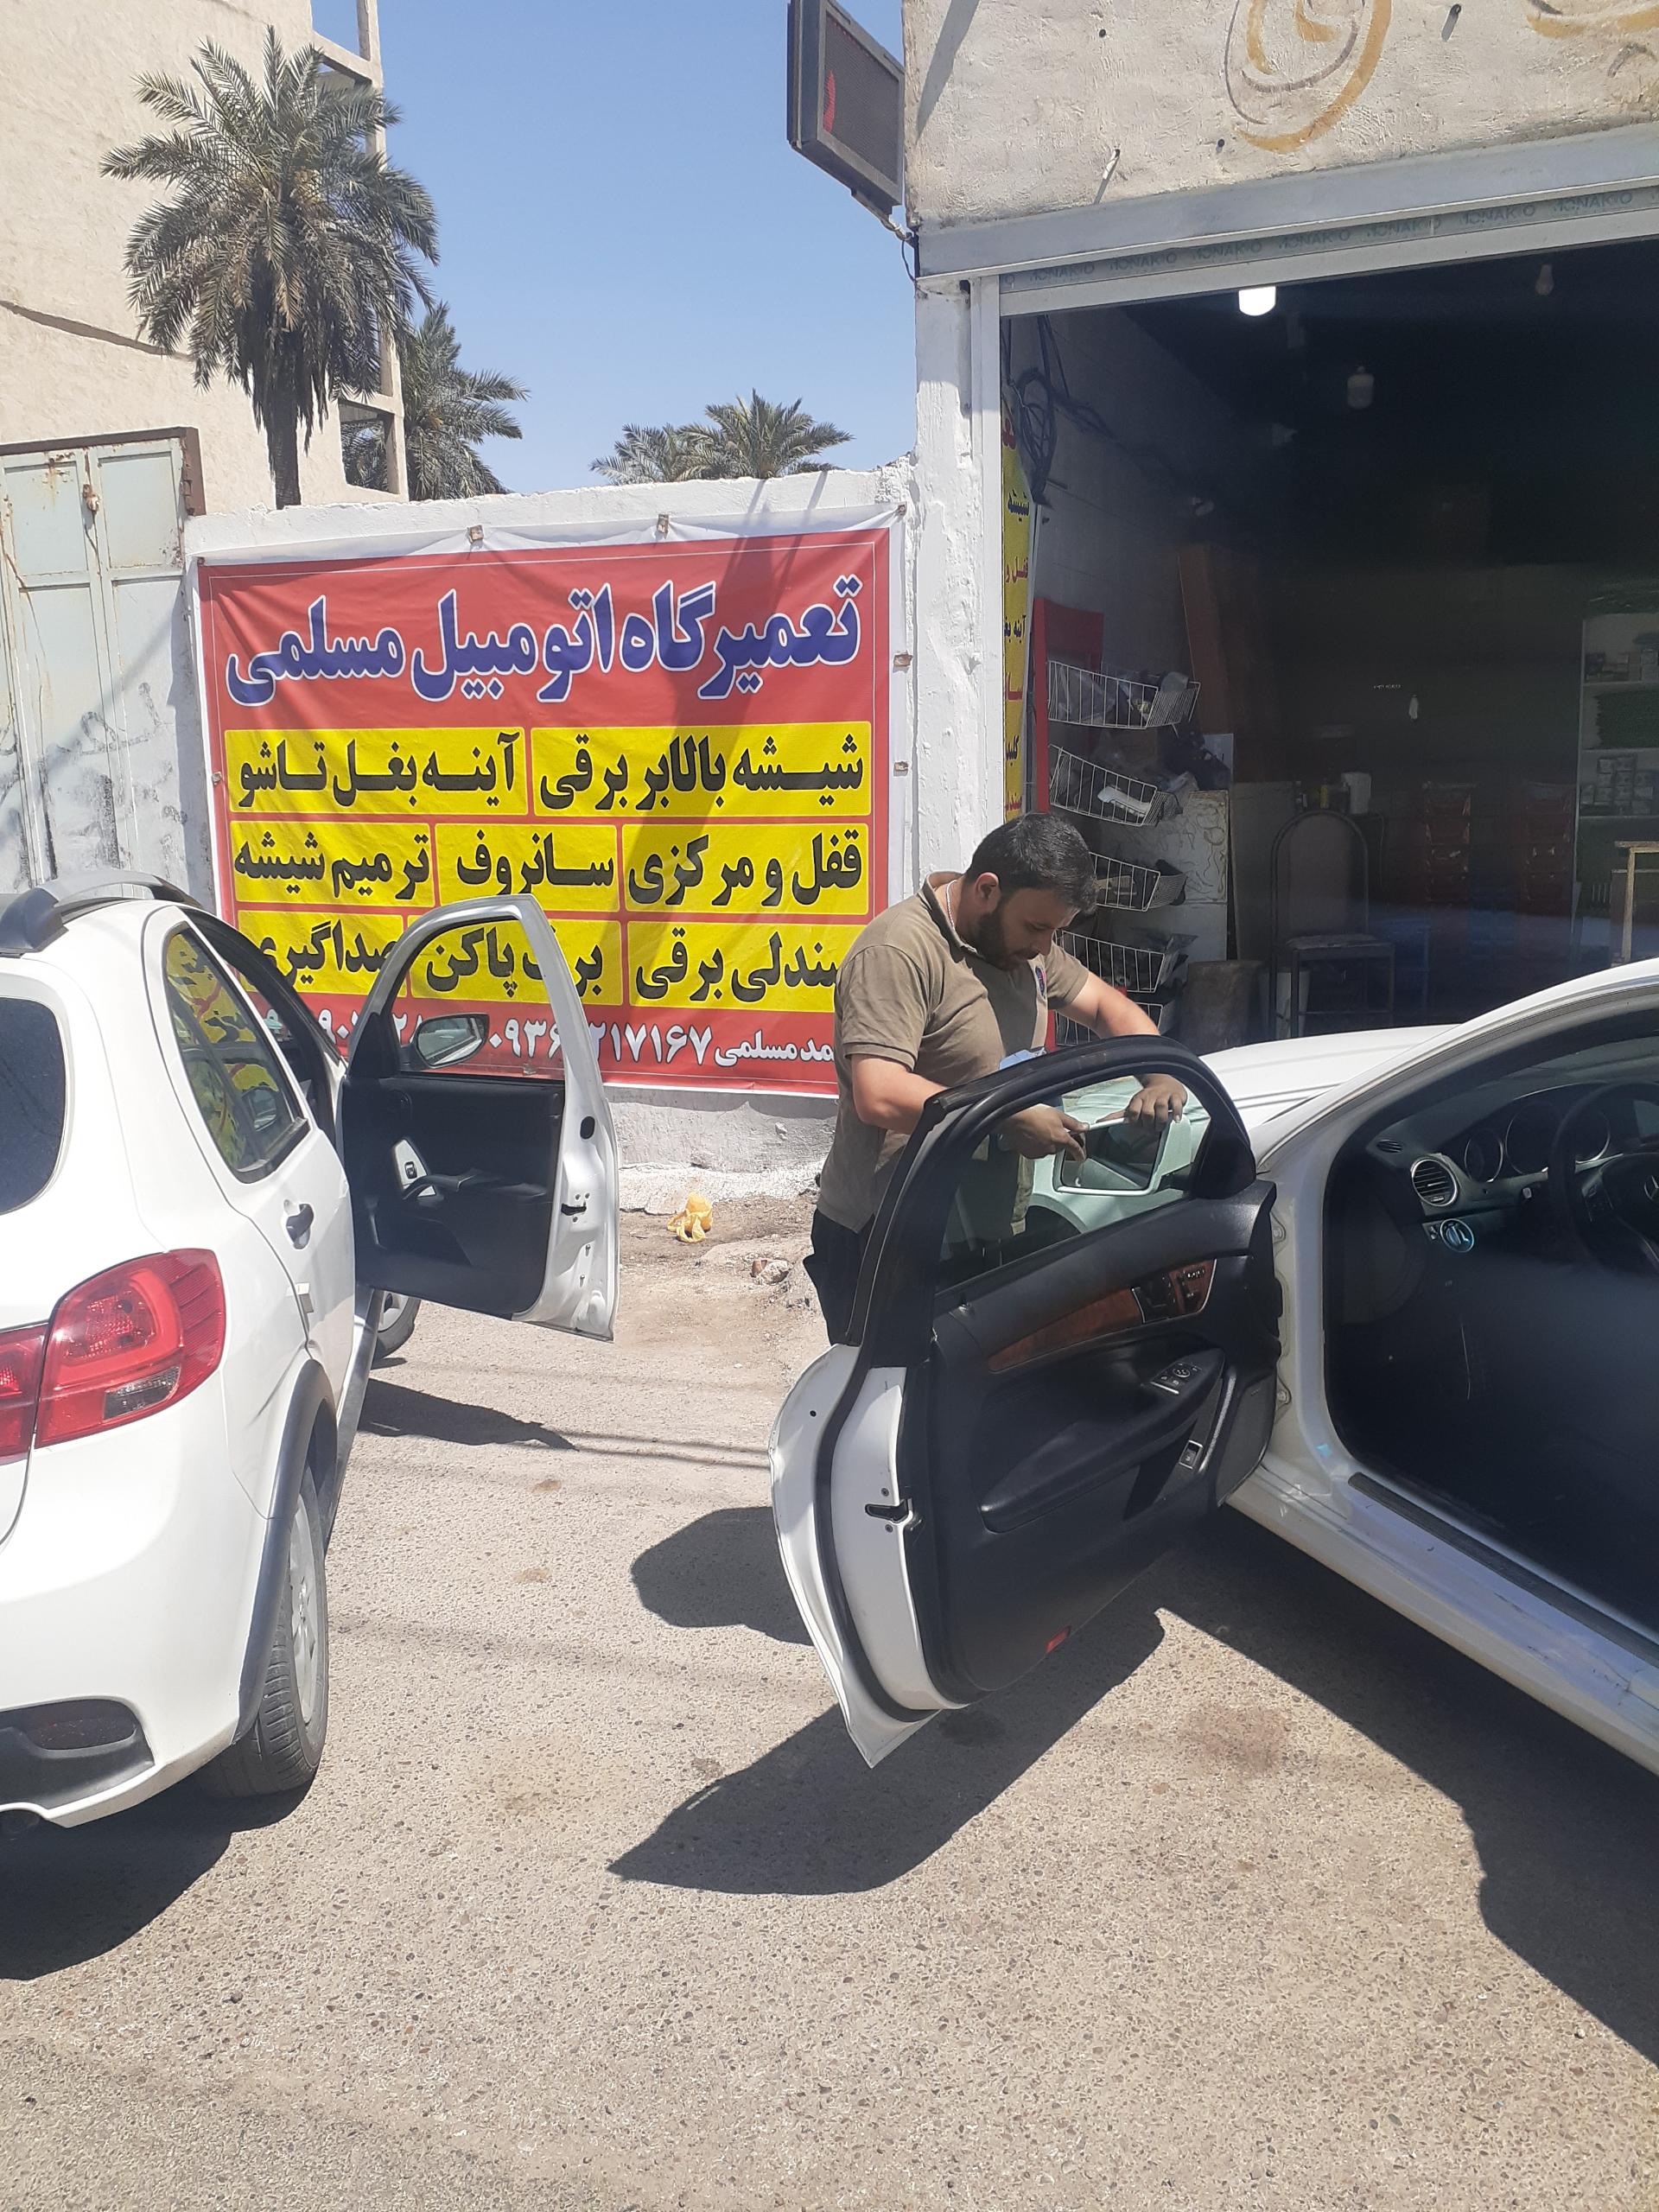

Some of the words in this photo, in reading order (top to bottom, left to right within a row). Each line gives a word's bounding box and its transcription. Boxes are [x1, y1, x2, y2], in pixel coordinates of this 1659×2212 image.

[226, 594, 405, 706] مسلمی
[410, 582, 615, 702] اتومبیل
[620, 574, 863, 701] تعمیرگاه
[238, 740, 327, 808] تاشو
[332, 739, 417, 807] بغل
[423, 732, 520, 806] آینه
[540, 734, 629, 810] برقی
[635, 734, 726, 810] بالابر
[732, 733, 864, 805] شیشه
[233, 830, 325, 893] شیشه
[331, 833, 429, 899] ترمیم
[456, 829, 614, 895] سانروف
[628, 834, 754, 906] مرکزی
[760, 857, 783, 906] و
[791, 829, 862, 906] قفل
[635, 927, 724, 1002] برقی
[731, 931, 838, 1002] ندلی
[715, 1028, 798, 1067] مسلمی
